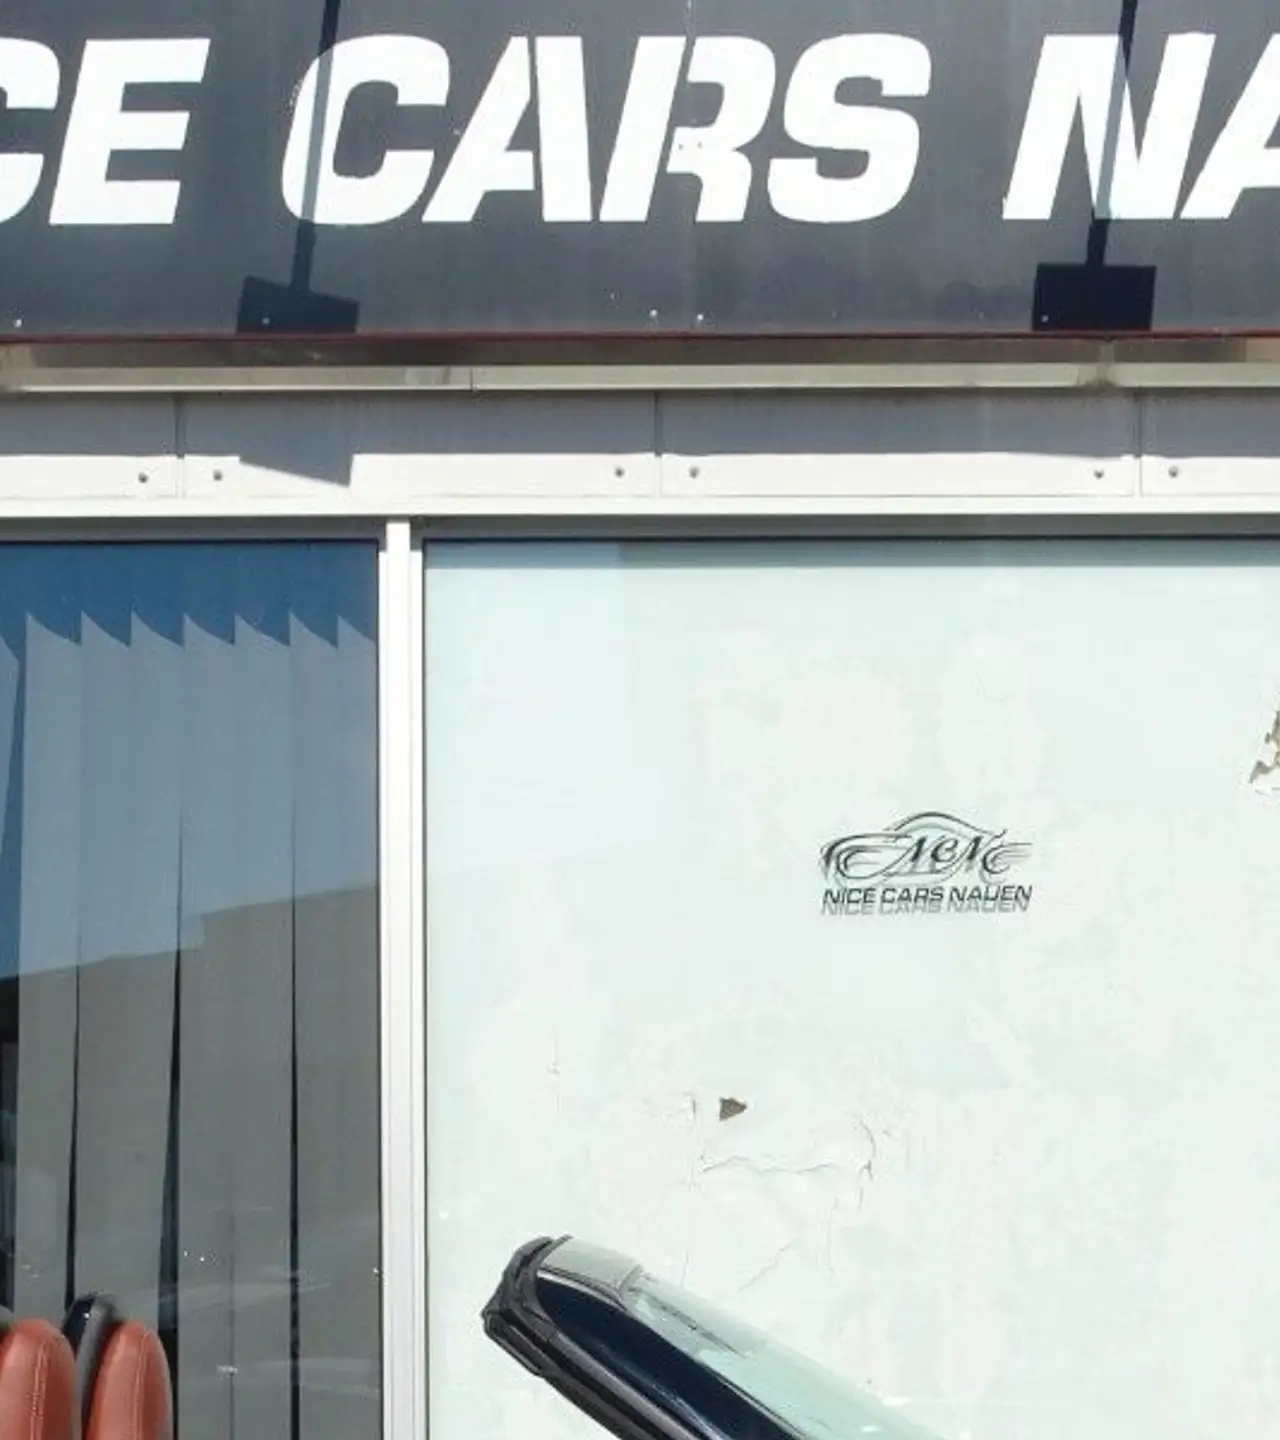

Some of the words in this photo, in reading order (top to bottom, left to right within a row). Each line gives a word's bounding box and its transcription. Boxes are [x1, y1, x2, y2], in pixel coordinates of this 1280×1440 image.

[282, 34, 932, 224] CARS
[823, 887, 876, 904] NICE
[880, 886, 945, 904] CARS
[948, 884, 1032, 902] NAUEN
